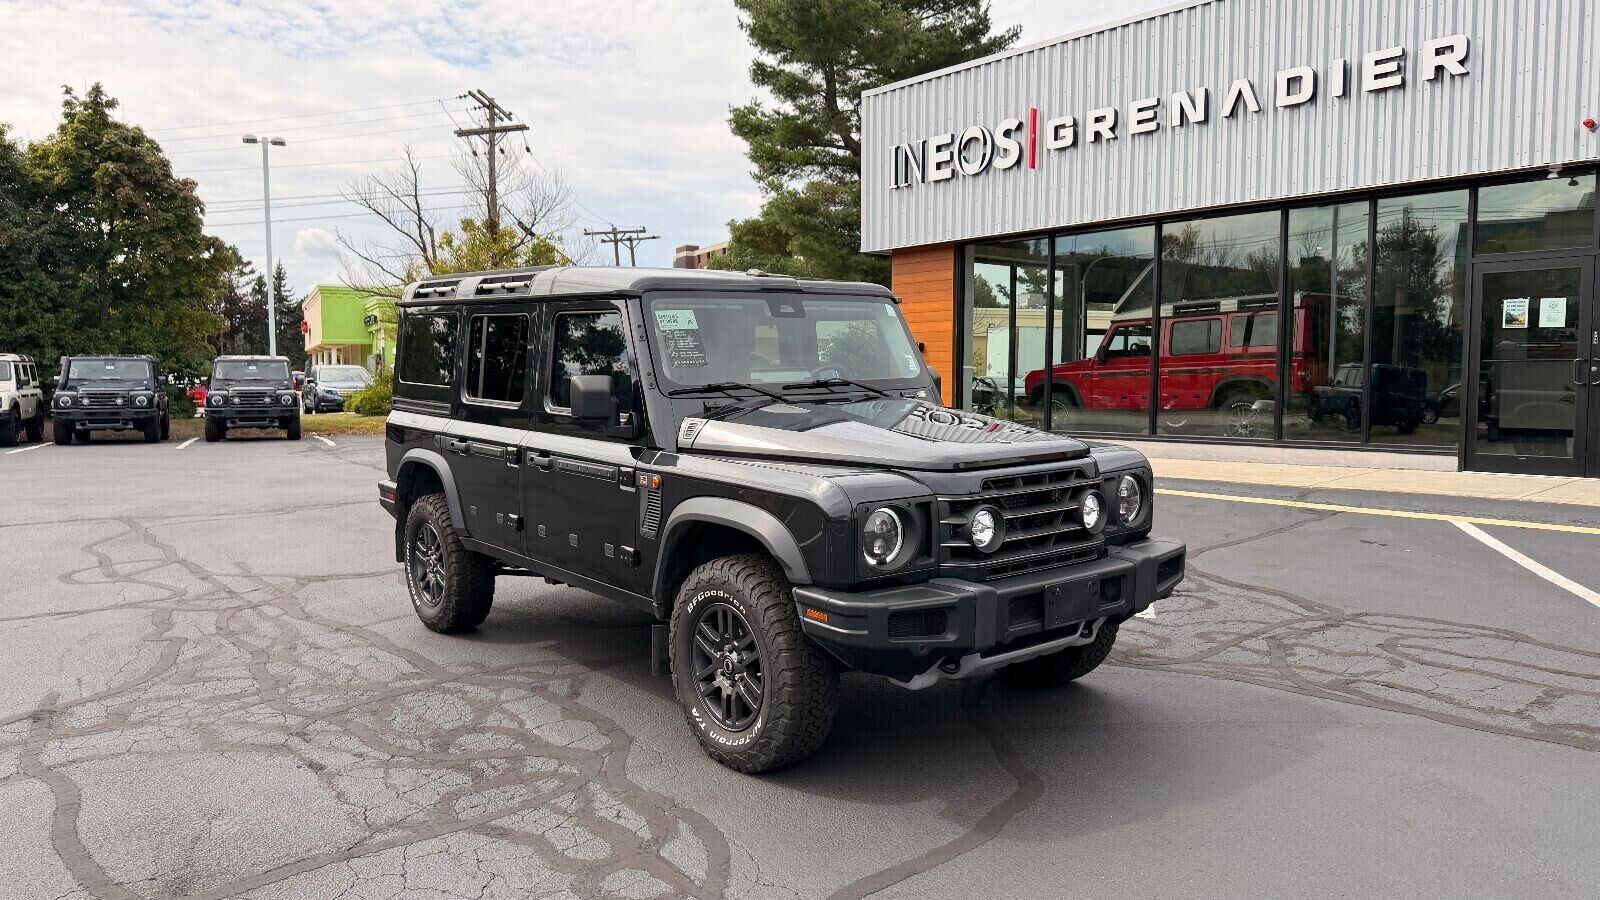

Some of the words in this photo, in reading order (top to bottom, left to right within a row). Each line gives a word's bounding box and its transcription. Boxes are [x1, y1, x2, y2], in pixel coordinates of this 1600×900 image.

[889, 118, 1023, 189] INEOS
[1047, 33, 1469, 150] GRENADIER
[687, 590, 746, 614] BFGoodrich
